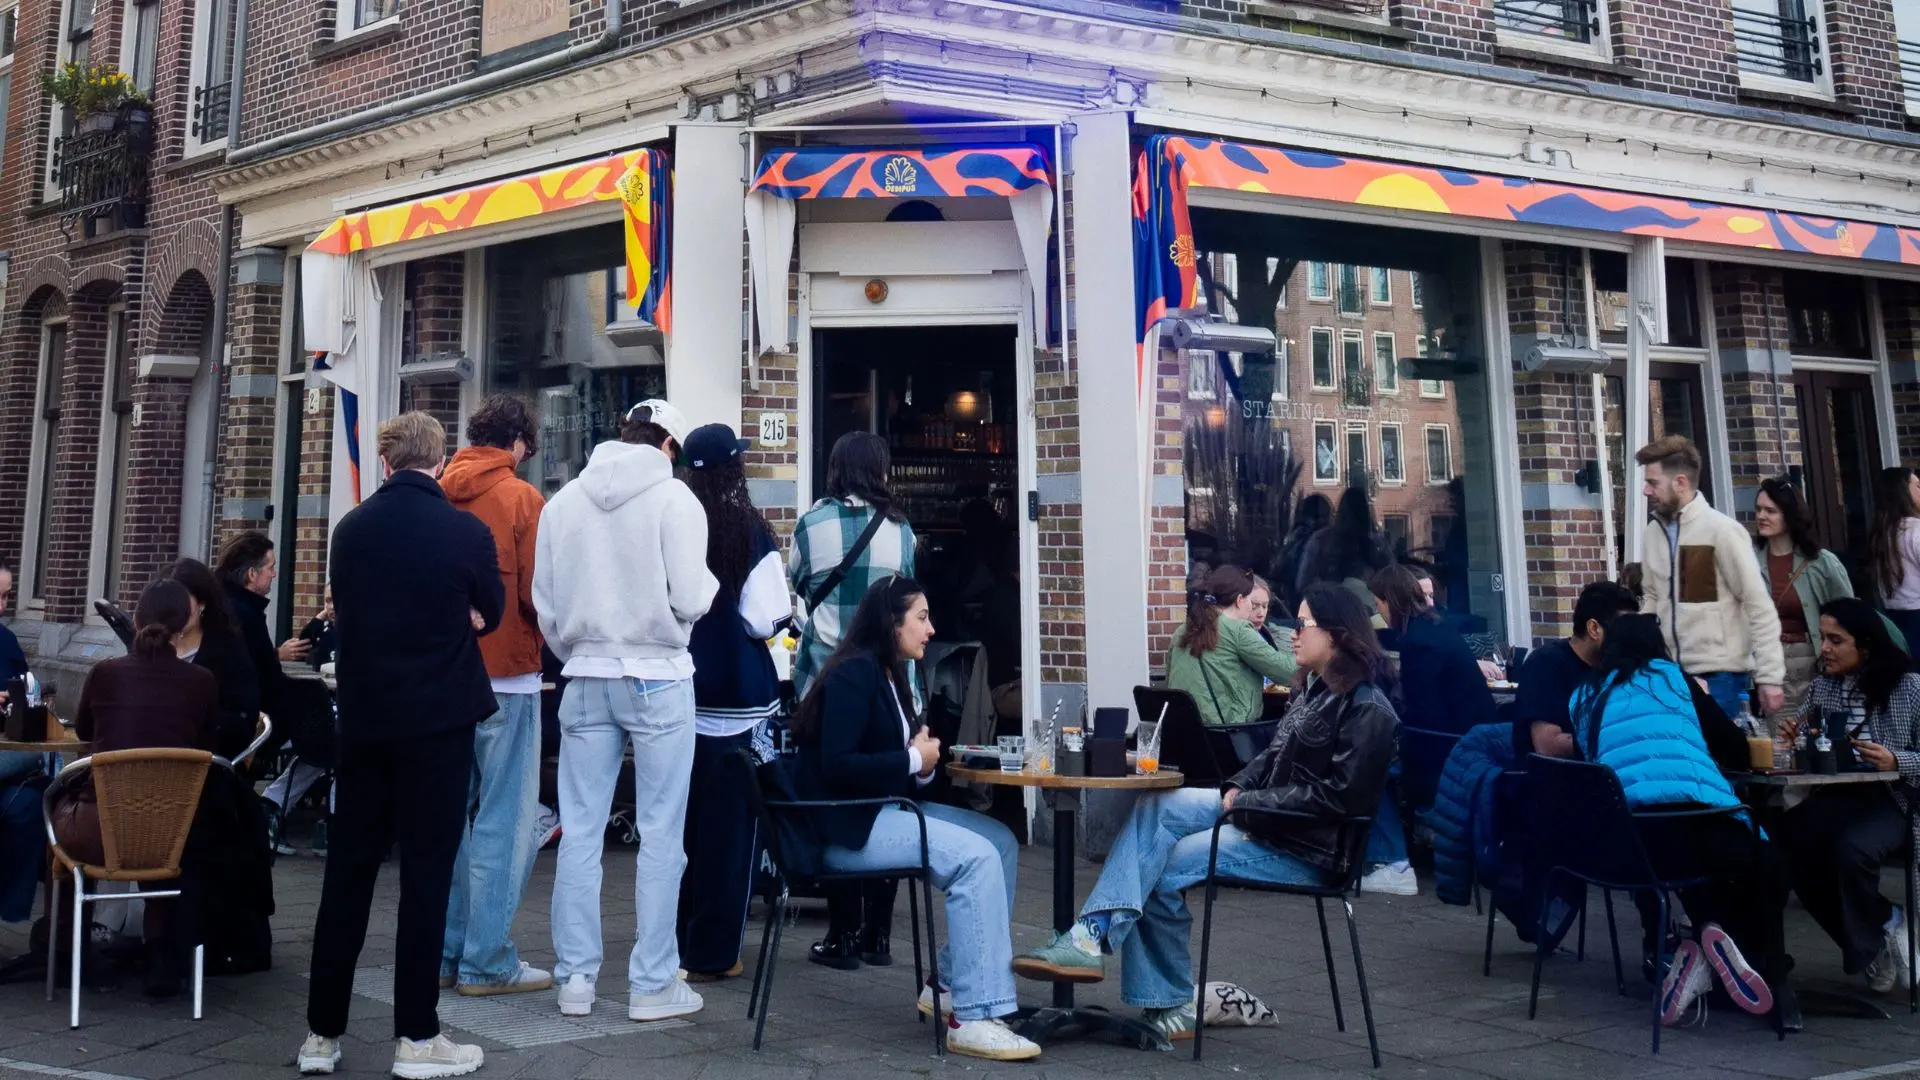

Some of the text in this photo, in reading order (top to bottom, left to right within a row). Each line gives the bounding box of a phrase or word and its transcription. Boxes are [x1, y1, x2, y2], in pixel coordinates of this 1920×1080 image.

[885, 184, 916, 192] OEDIPUS
[1242, 399, 1325, 420] STARING
[763, 418, 785, 441] 215
